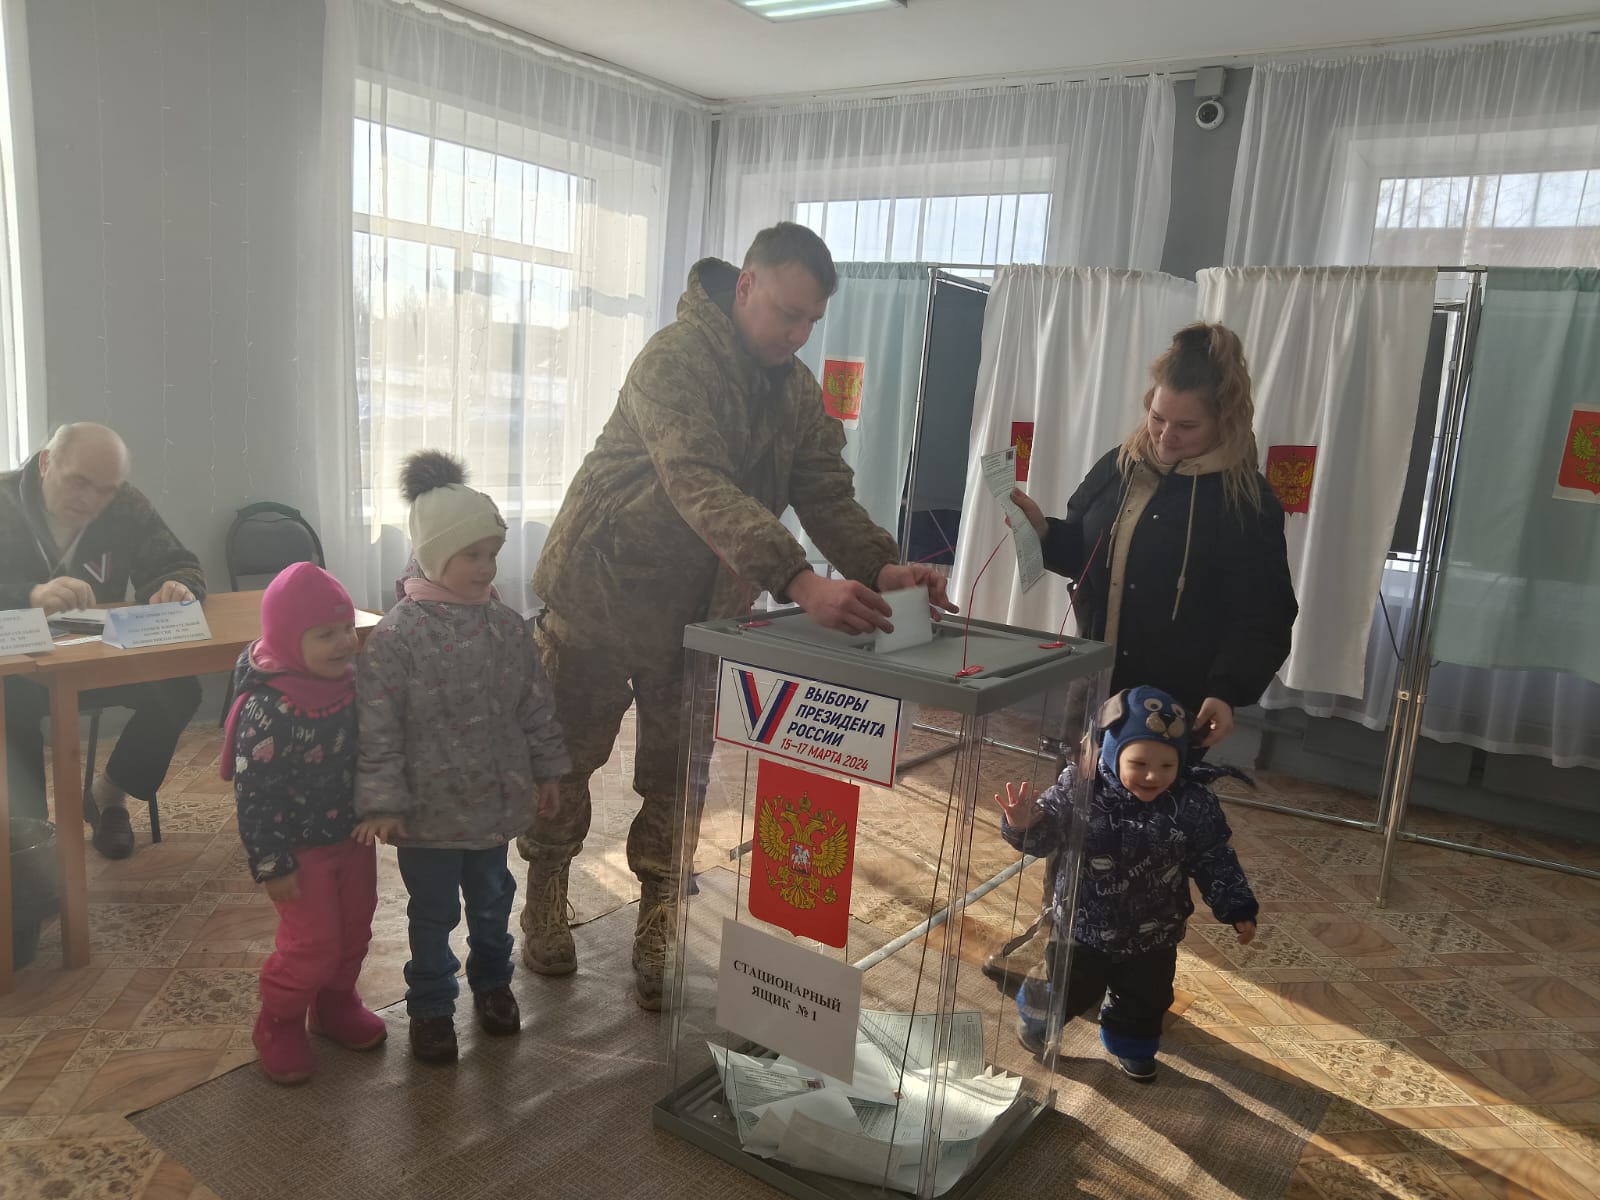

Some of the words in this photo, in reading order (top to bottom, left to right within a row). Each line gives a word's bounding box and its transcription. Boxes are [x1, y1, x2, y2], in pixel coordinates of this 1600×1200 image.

[804, 686, 869, 713] ВЫБОРЫ
[786, 721, 845, 747] РОССИИ
[795, 704, 886, 739] ПРЕЗИДЕНТА
[807, 745, 842, 765] МАРТА
[842, 755, 869, 772] 2024
[733, 960, 841, 1013] СТАЦИОНАРНЫЙ
[751, 985, 792, 1010] ЯЩИК
[795, 1004, 809, 1018] №
[812, 1010, 818, 1021] 1
